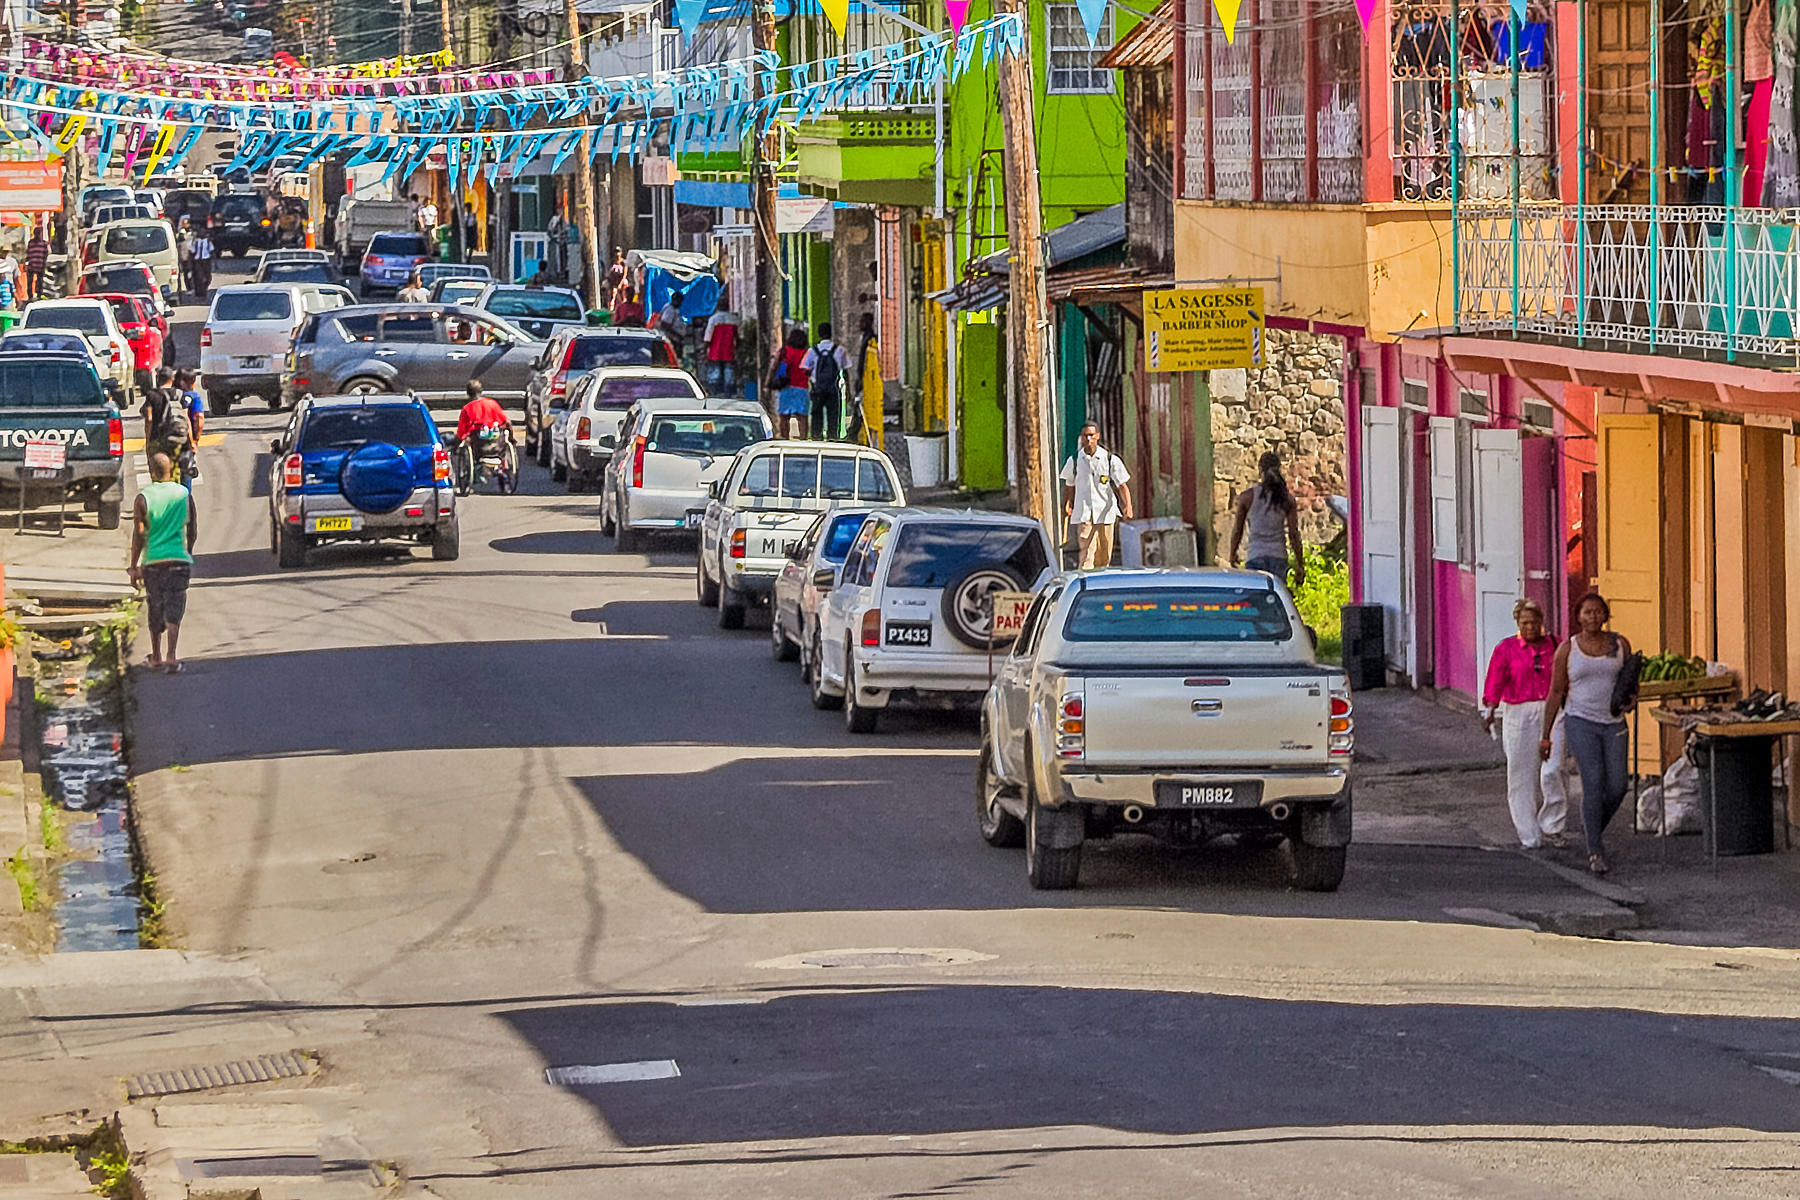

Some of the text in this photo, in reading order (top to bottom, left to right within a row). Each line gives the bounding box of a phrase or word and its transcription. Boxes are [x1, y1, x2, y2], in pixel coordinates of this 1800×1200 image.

[1154, 294, 1255, 310] LA SAGESSE
[1182, 309, 1226, 320] UNISEX
[1163, 319, 1247, 331] BARBER SHOP
[0, 429, 90, 448] TOYOTA
[997, 616, 1024, 629] PAR
[1182, 787, 1233, 804] PM882
